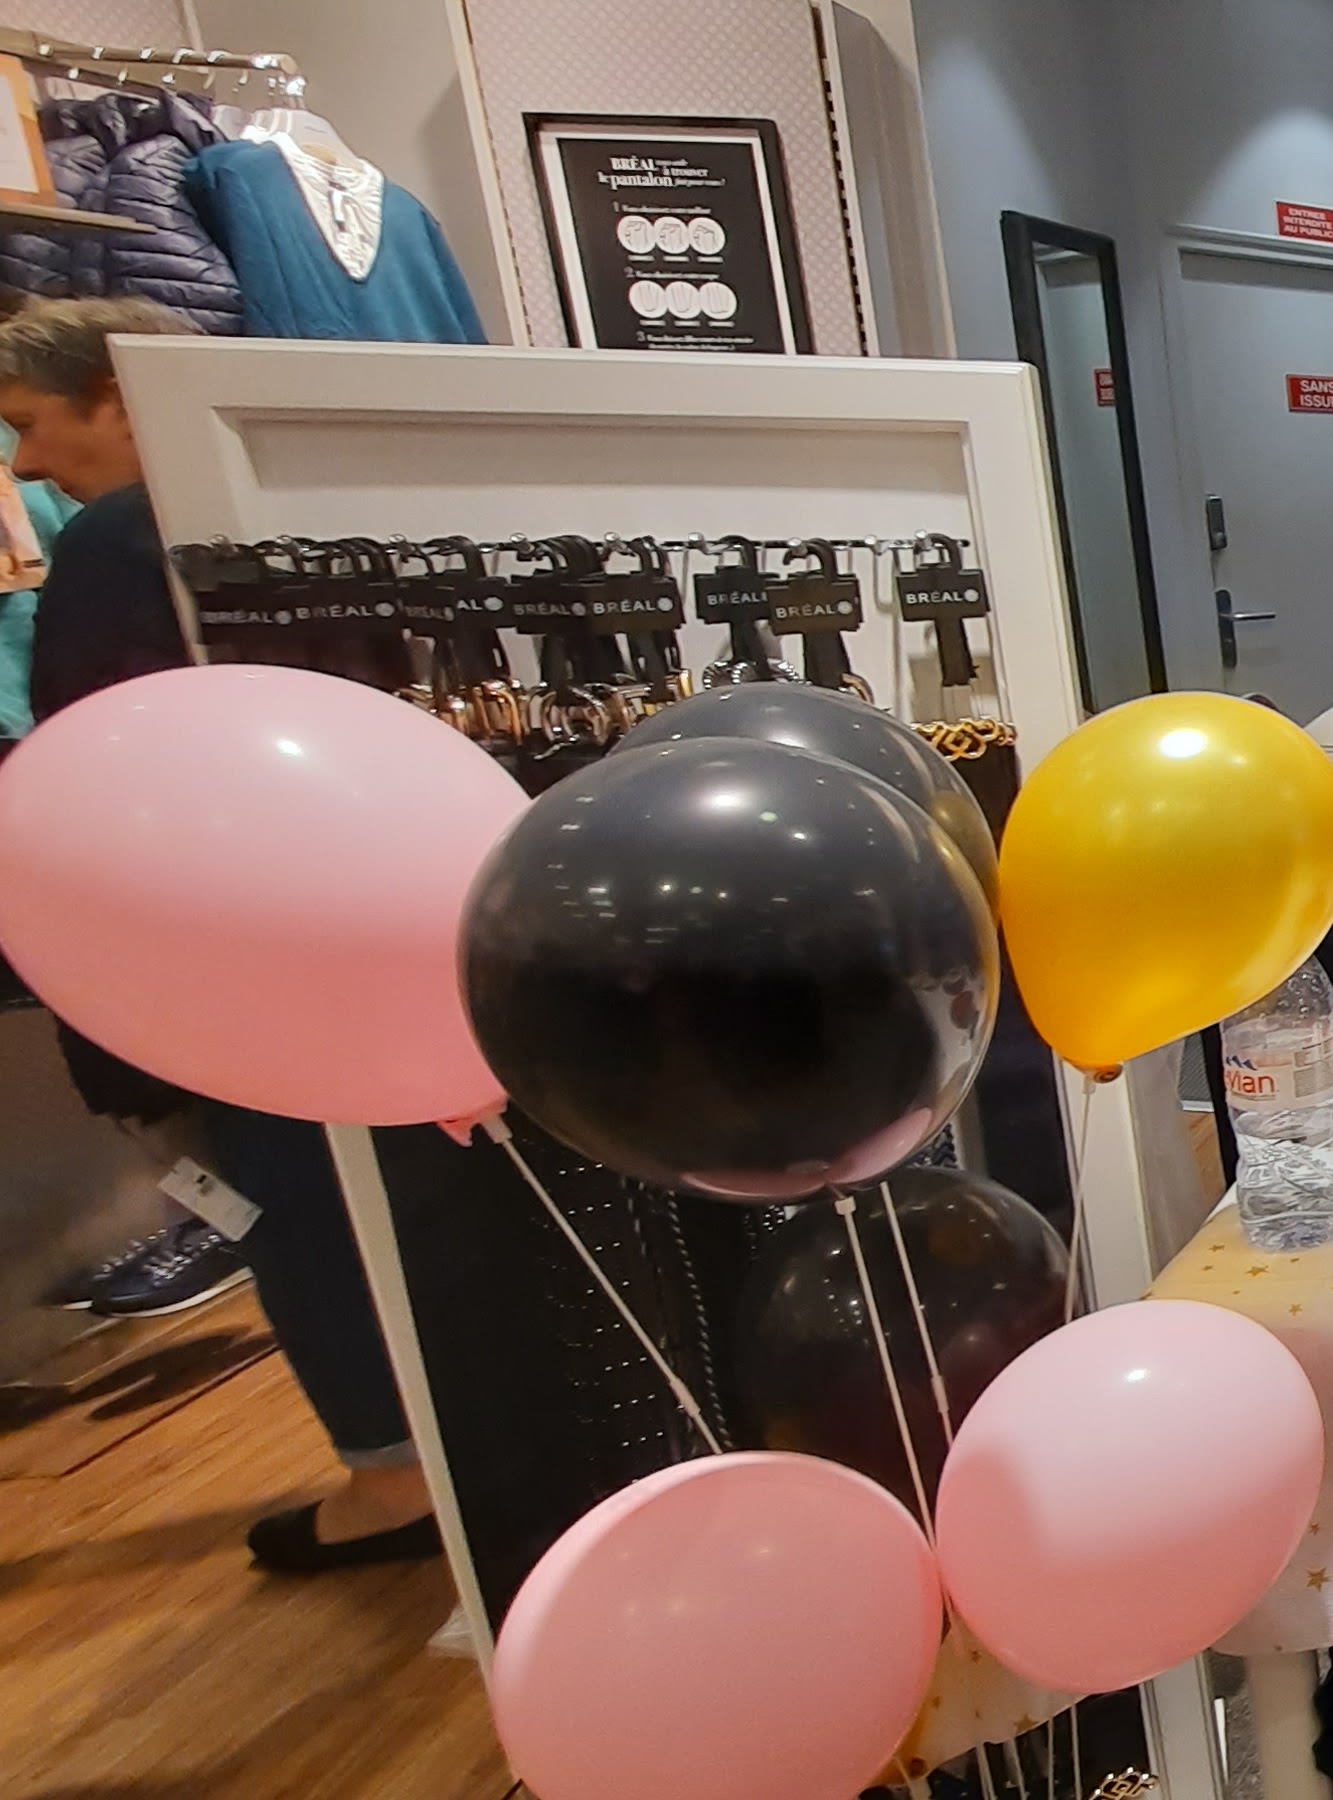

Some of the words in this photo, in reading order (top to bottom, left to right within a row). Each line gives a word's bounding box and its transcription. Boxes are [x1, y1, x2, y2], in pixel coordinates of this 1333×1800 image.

[609, 155, 659, 171] BRÉAL
[610, 172, 673, 190] pantalon
[1299, 227, 1333, 238] PUBLIC
[296, 604, 374, 619] BRÉAL
[593, 599, 656, 614] BRÉAL
[775, 603, 836, 619] BRÉAL
[1226, 1070, 1275, 1094] vian
